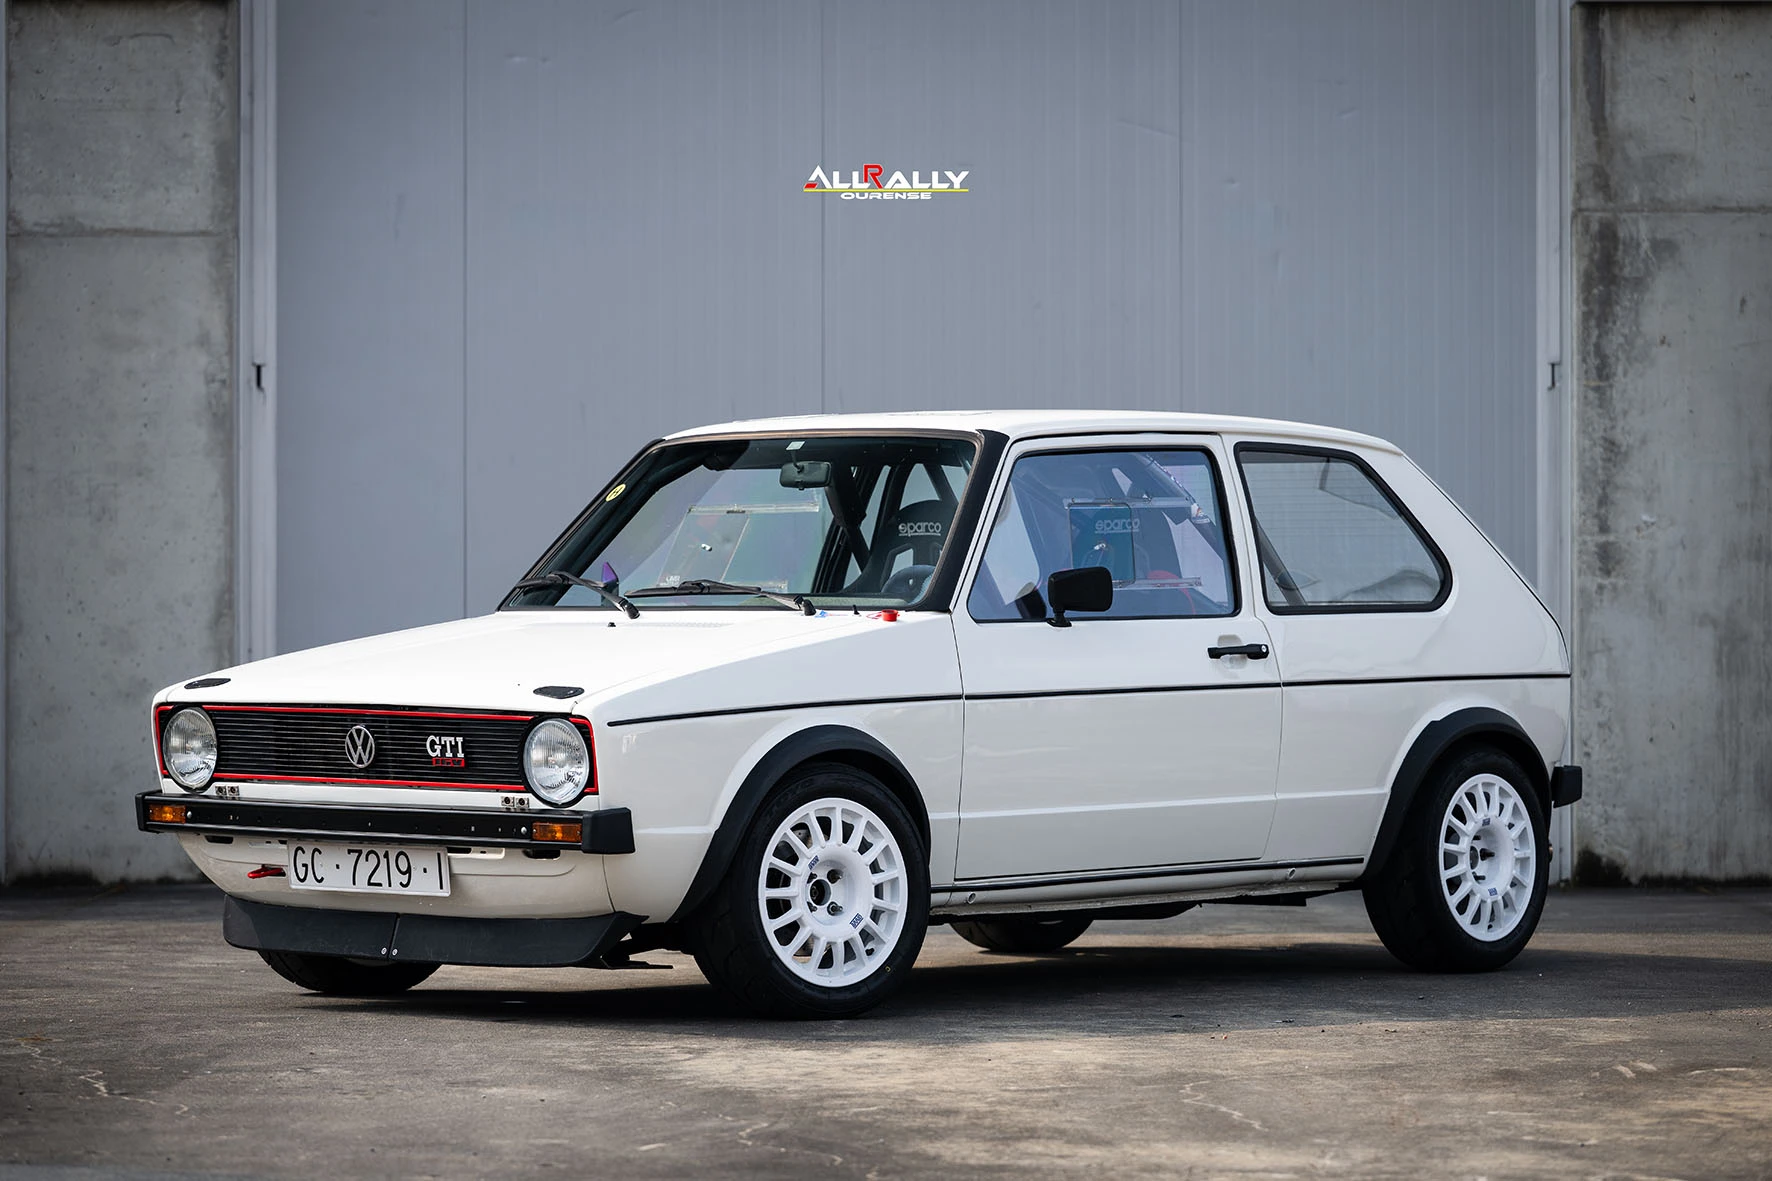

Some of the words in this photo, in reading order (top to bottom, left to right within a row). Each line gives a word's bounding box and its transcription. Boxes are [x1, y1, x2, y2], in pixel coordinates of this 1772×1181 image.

[898, 522, 941, 537] sparco
[426, 735, 464, 757] GTI
[293, 846, 324, 884] GC
[347, 849, 412, 888] 7219
